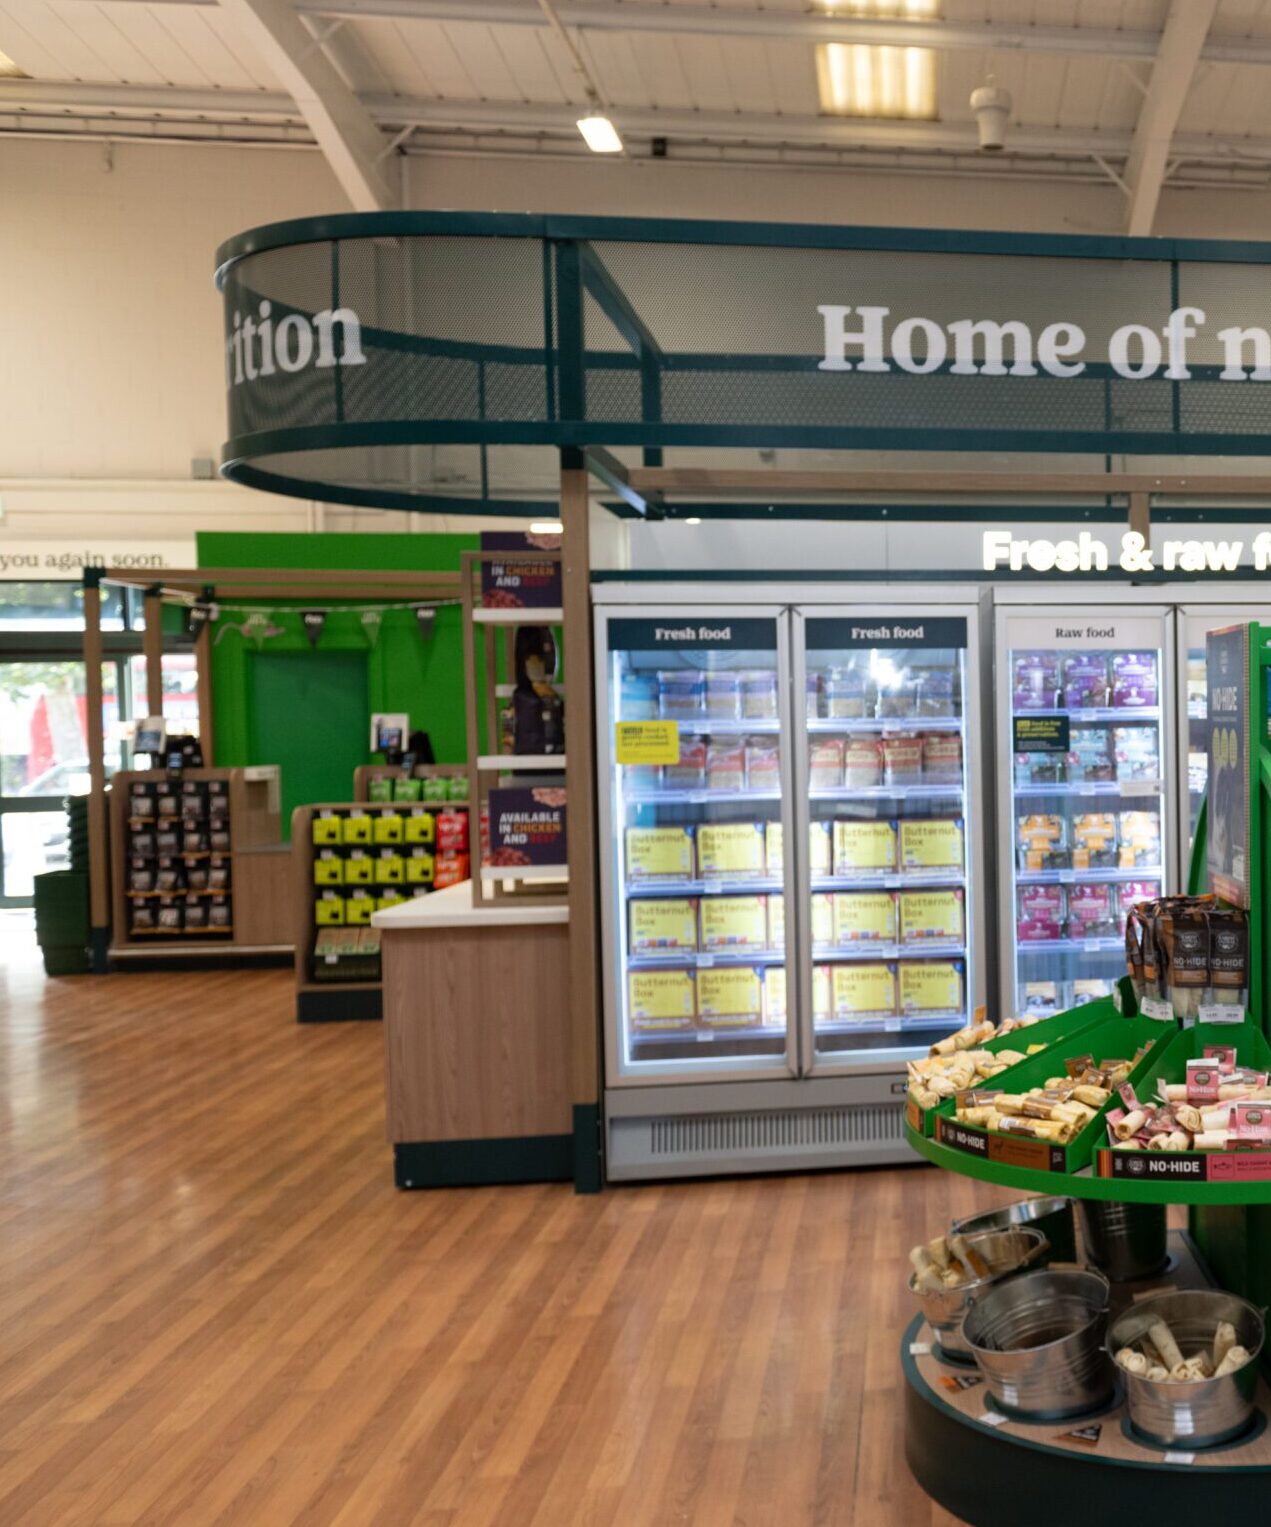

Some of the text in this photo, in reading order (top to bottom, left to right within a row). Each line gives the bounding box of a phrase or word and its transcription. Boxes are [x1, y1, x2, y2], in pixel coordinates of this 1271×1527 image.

[816, 304, 1087, 377] Home
[1108, 307, 1205, 380] of
[982, 531, 1109, 572] Fresh
[1120, 531, 1154, 572] &
[1163, 540, 1243, 571] raw
[45, 551, 106, 572] again
[112, 553, 169, 569] soon.
[491, 566, 504, 577] IN
[496, 577, 520, 588] AND
[655, 627, 732, 640] Fresh food
[851, 626, 925, 639] Fresh food
[1055, 626, 1116, 638] Raw food
[500, 812, 560, 823] AVAILABLE
[499, 823, 562, 835] IN CHICKEN
[503, 834, 528, 845] AND
[956, 1131, 986, 1150] NO-HIDE
[1149, 1160, 1200, 1173] NO-HIDE
